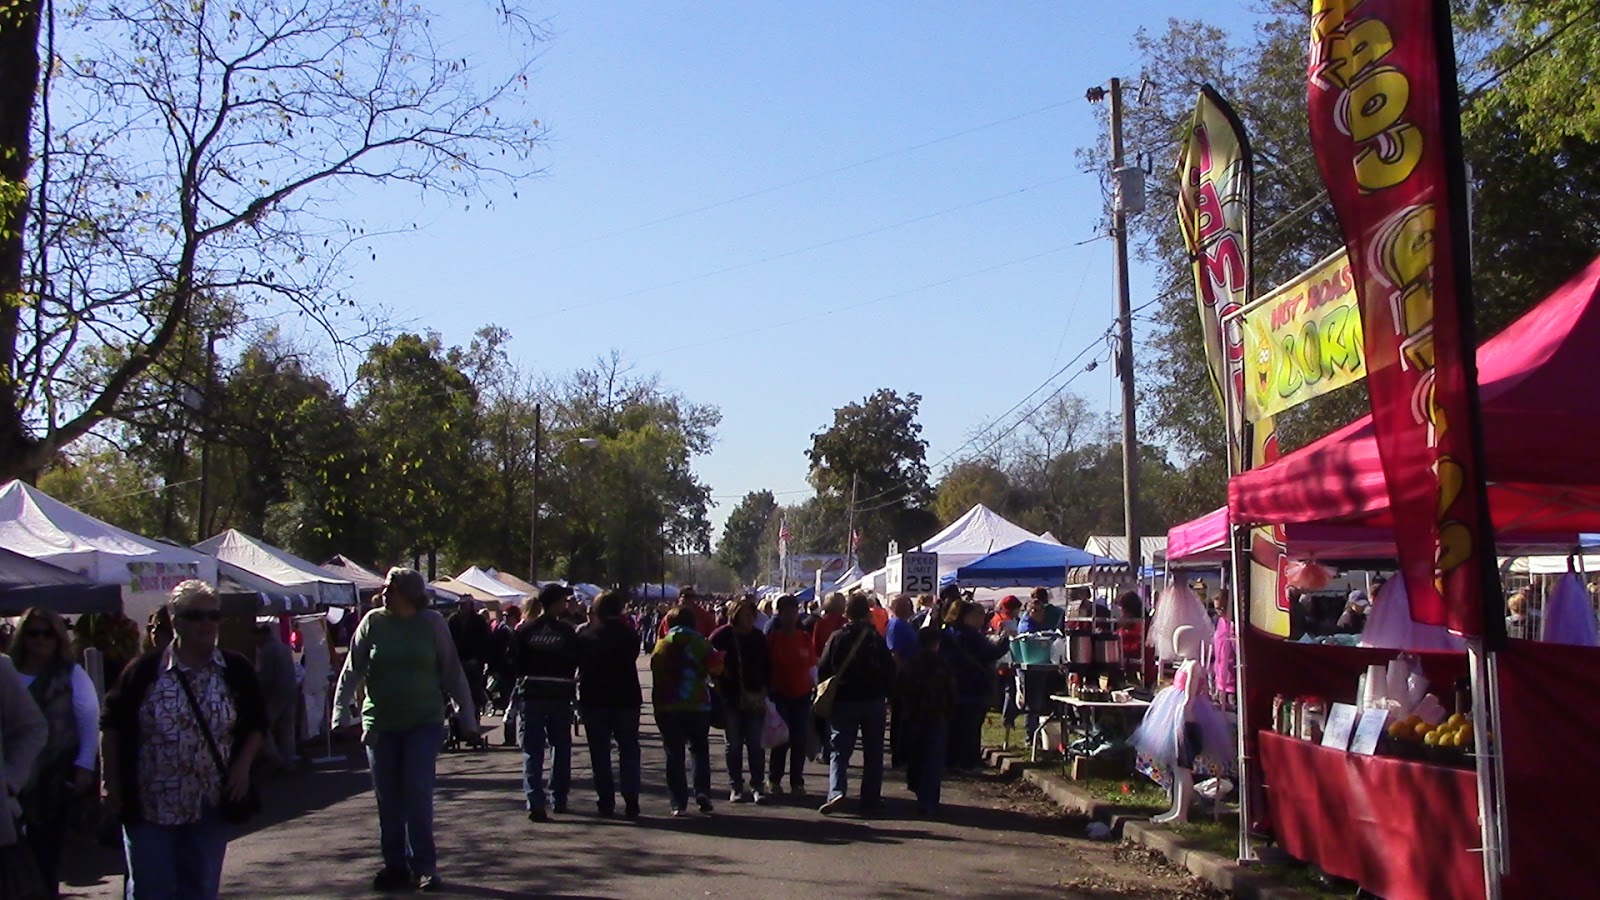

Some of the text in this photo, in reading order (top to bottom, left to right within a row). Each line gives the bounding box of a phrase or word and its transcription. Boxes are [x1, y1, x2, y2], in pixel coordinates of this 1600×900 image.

[1271, 265, 1353, 332] HOT ROAS
[906, 556, 935, 565] SPEED
[907, 566, 931, 574] LIMIT
[906, 575, 933, 592] 25
